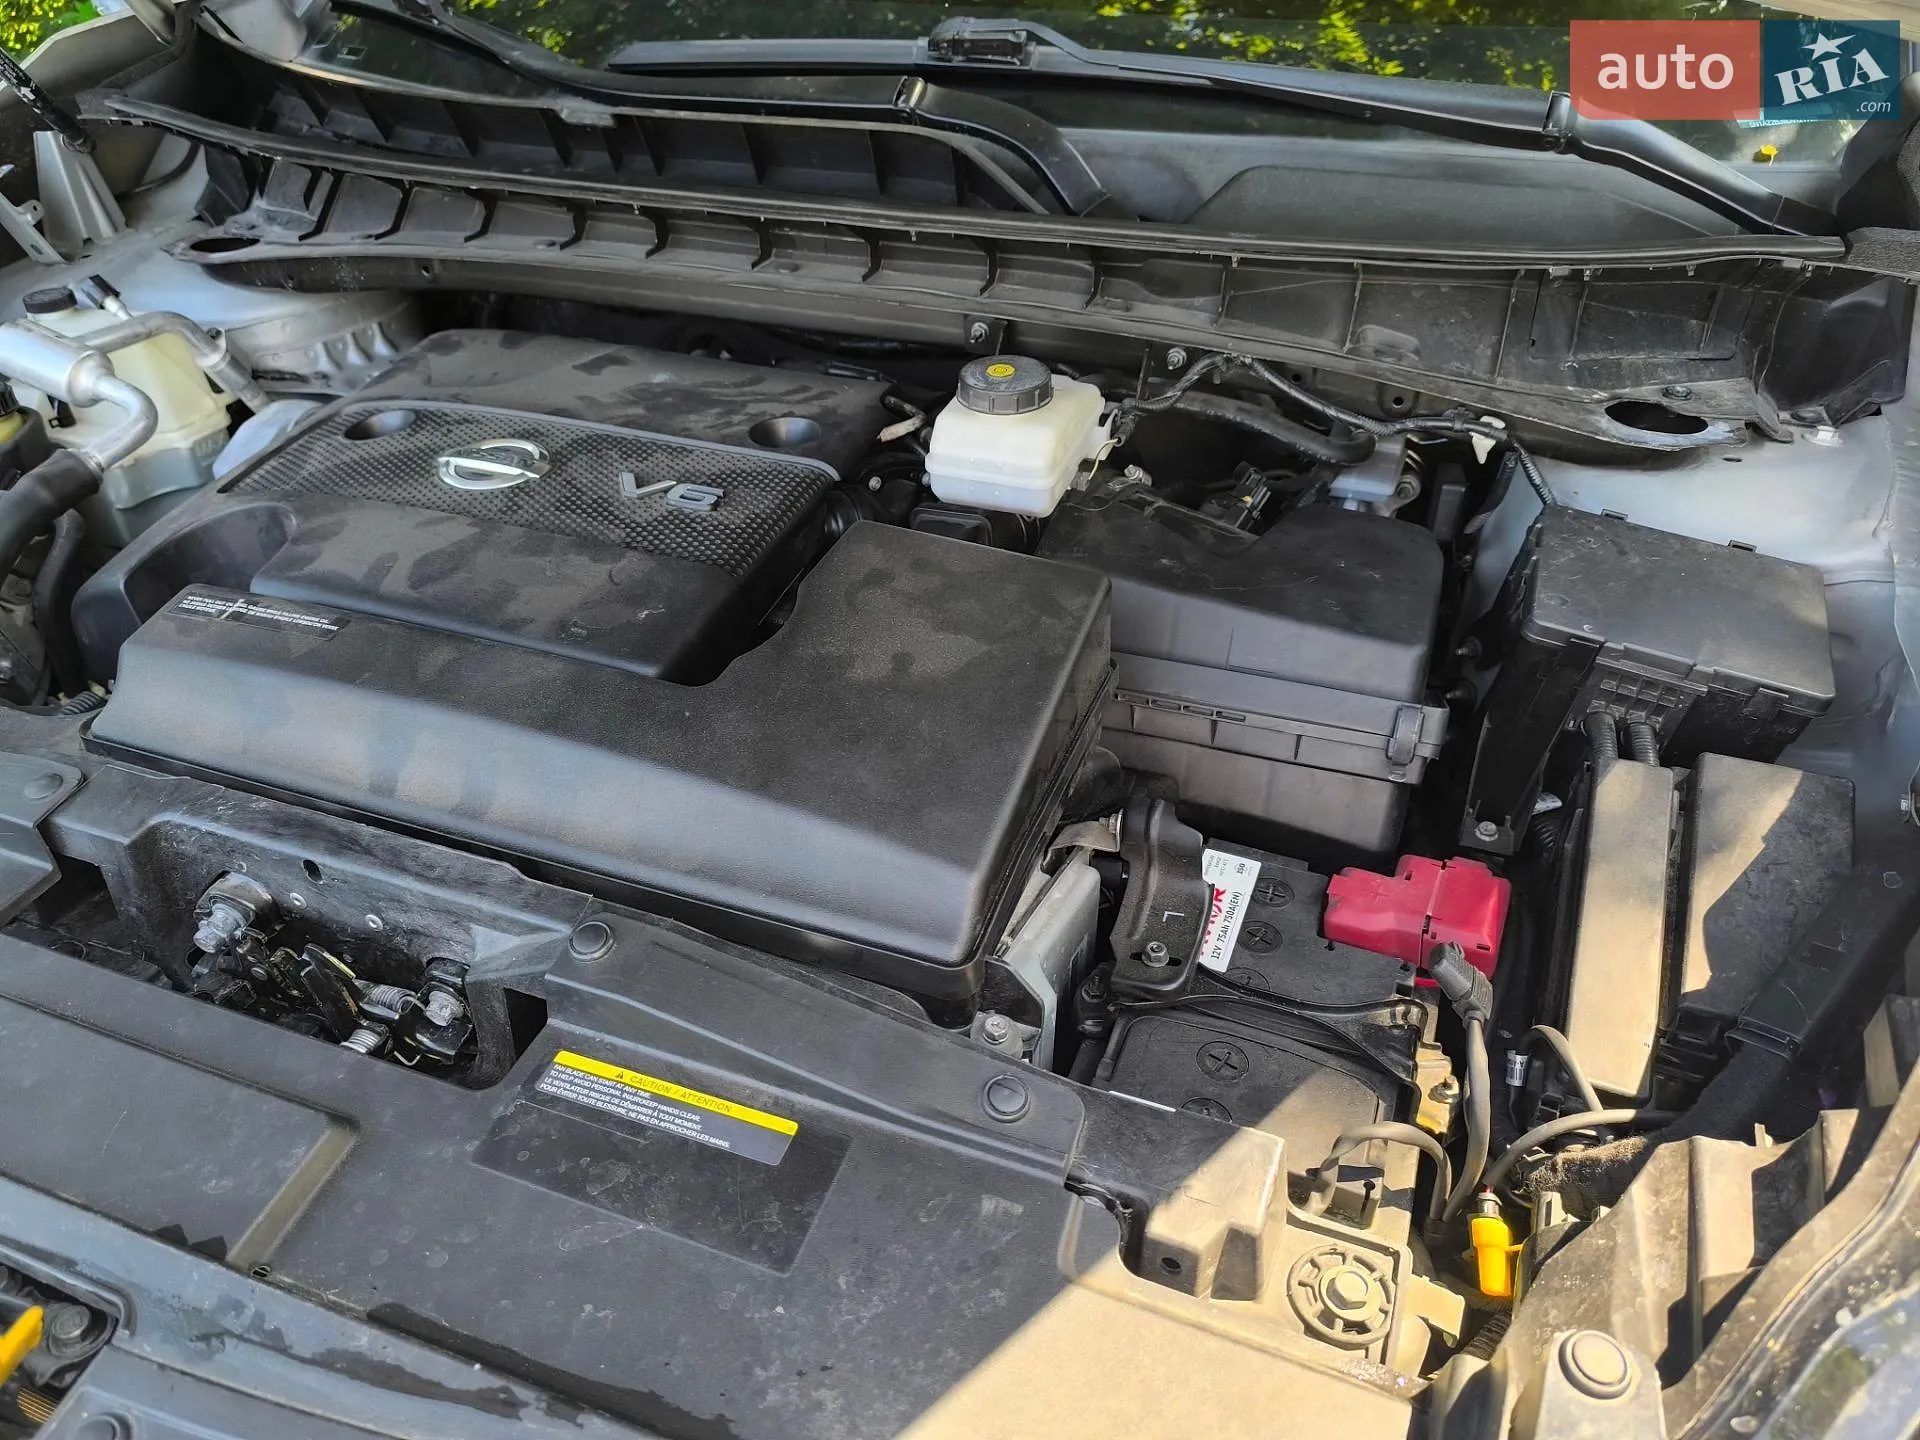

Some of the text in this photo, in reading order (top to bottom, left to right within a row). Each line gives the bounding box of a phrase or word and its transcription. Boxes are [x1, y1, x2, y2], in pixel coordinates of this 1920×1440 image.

[618, 471, 725, 512] V6
[1211, 944, 1223, 960] 12V
[1217, 923, 1230, 945] 75Ah
[1224, 891, 1243, 925] 750A(EN)
[558, 1073, 574, 1081] HELP
[573, 1077, 592, 1086] AVOID
[591, 1083, 622, 1095] PERSONAL
[657, 1104, 680, 1114] HANDS
[630, 1075, 672, 1094] CAUTION
[680, 1091, 732, 1113] ATTENTION
